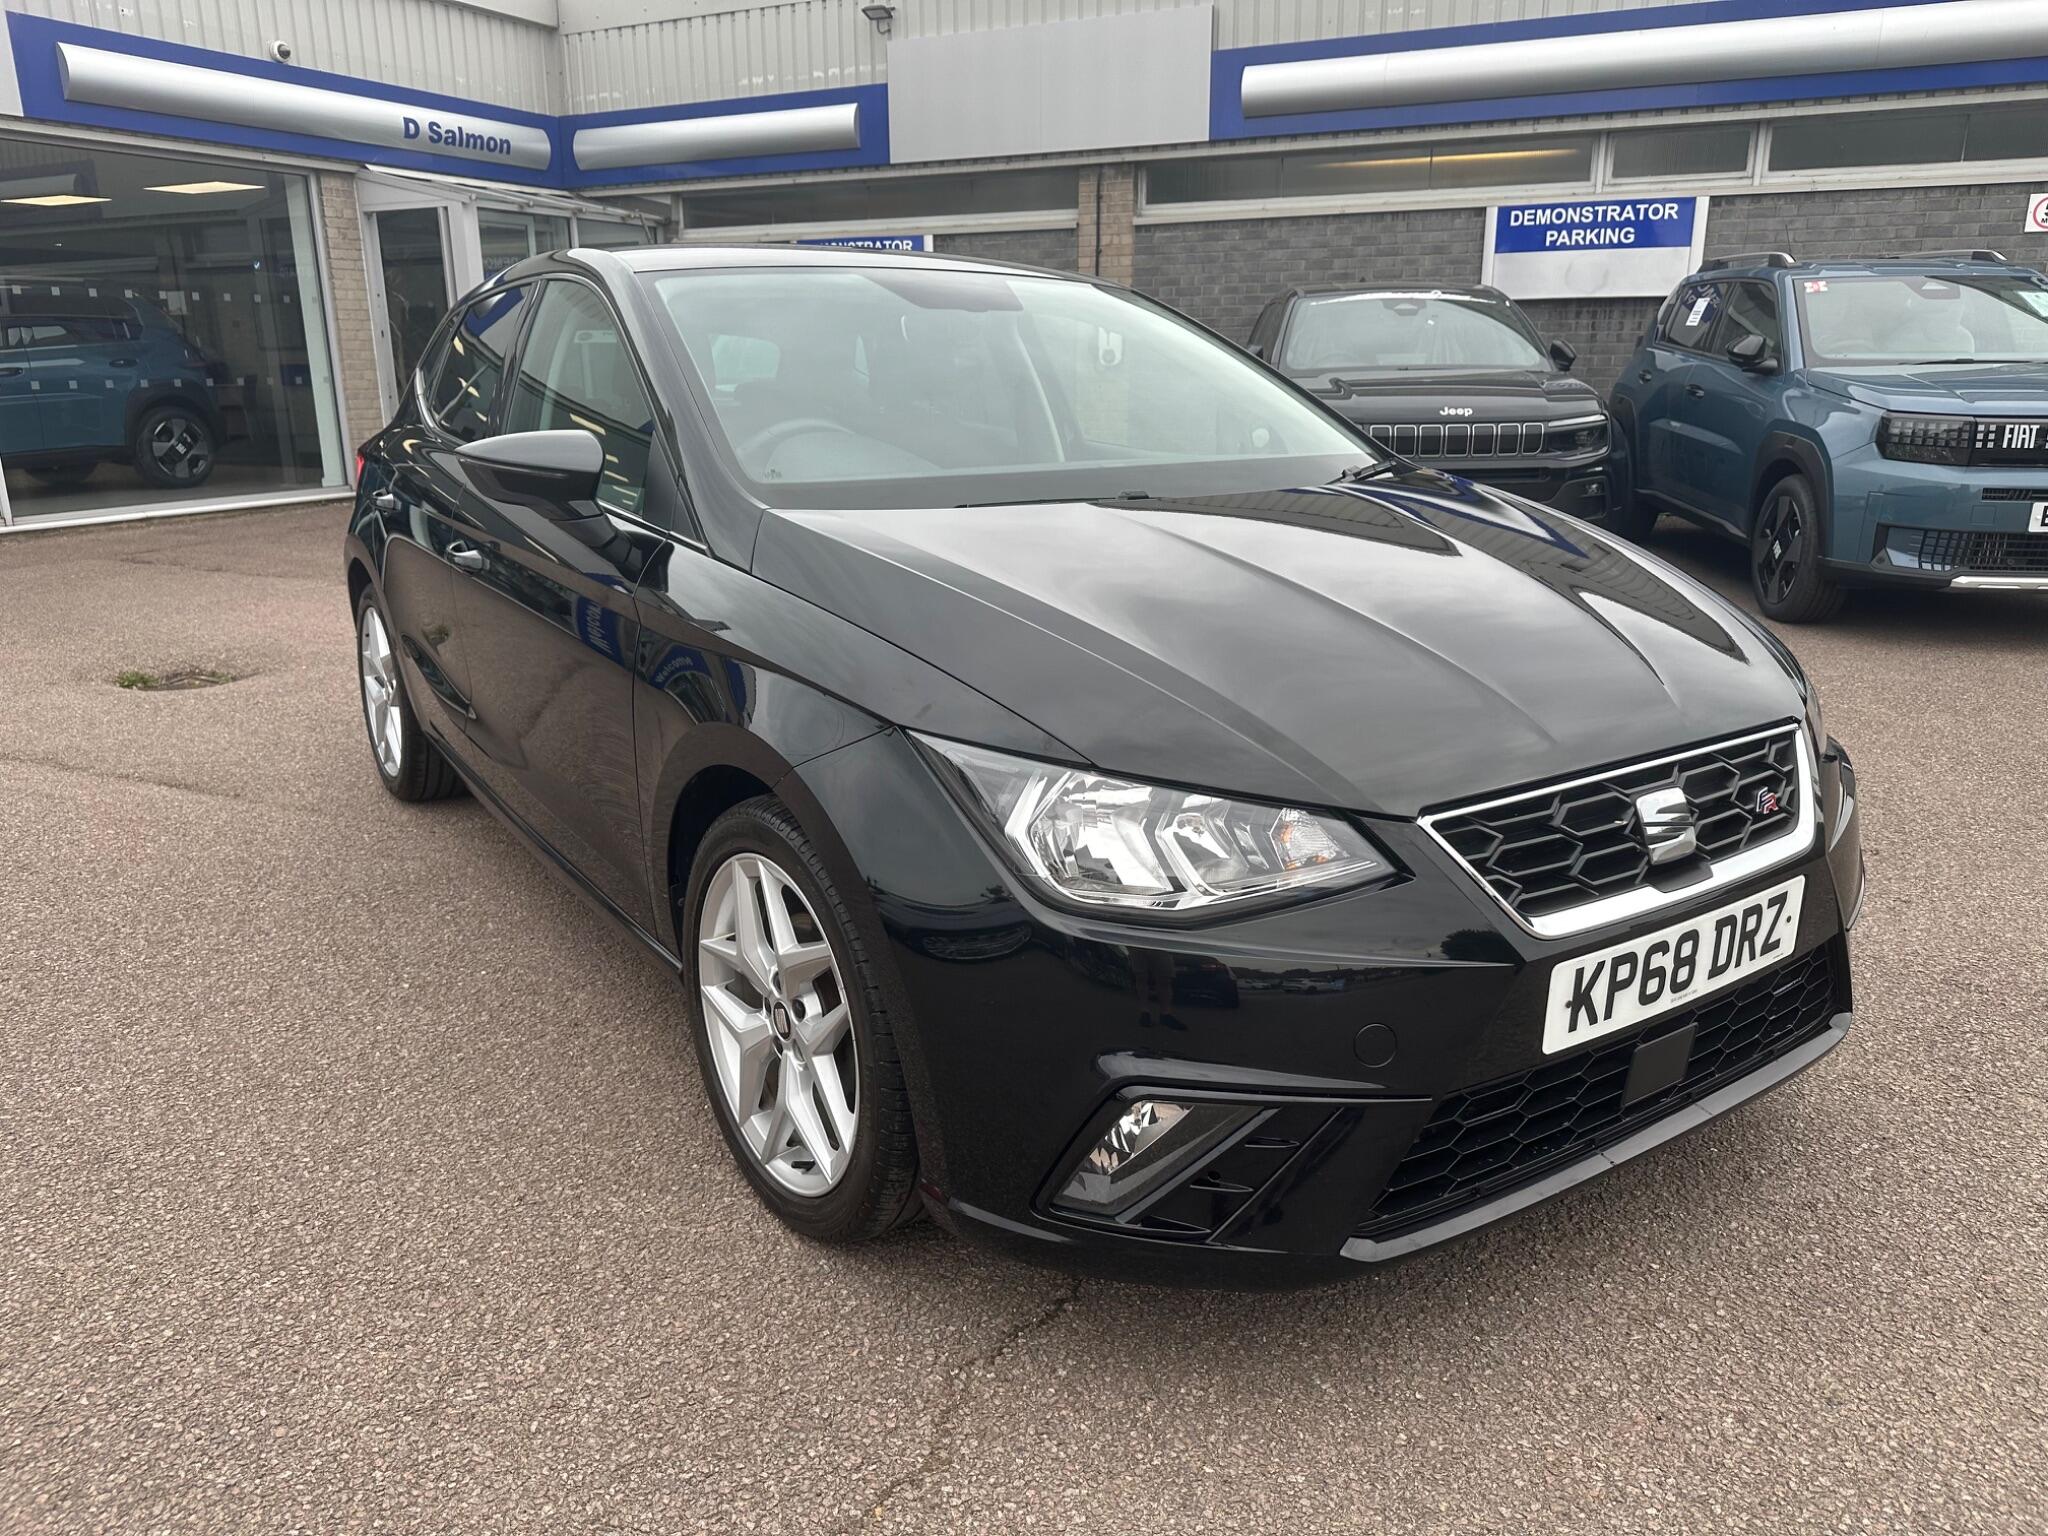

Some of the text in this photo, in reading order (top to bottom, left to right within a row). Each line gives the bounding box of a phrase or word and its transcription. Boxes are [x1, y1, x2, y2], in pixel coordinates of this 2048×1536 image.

[403, 116, 511, 155] D Salmon
[1510, 203, 1679, 226] DEMONSTRATOR
[1545, 227, 1635, 247] PARKING
[1440, 406, 1473, 417] Jeep
[2002, 424, 2040, 449] FIAT
[1568, 890, 1789, 1033] KP68 DRZ
